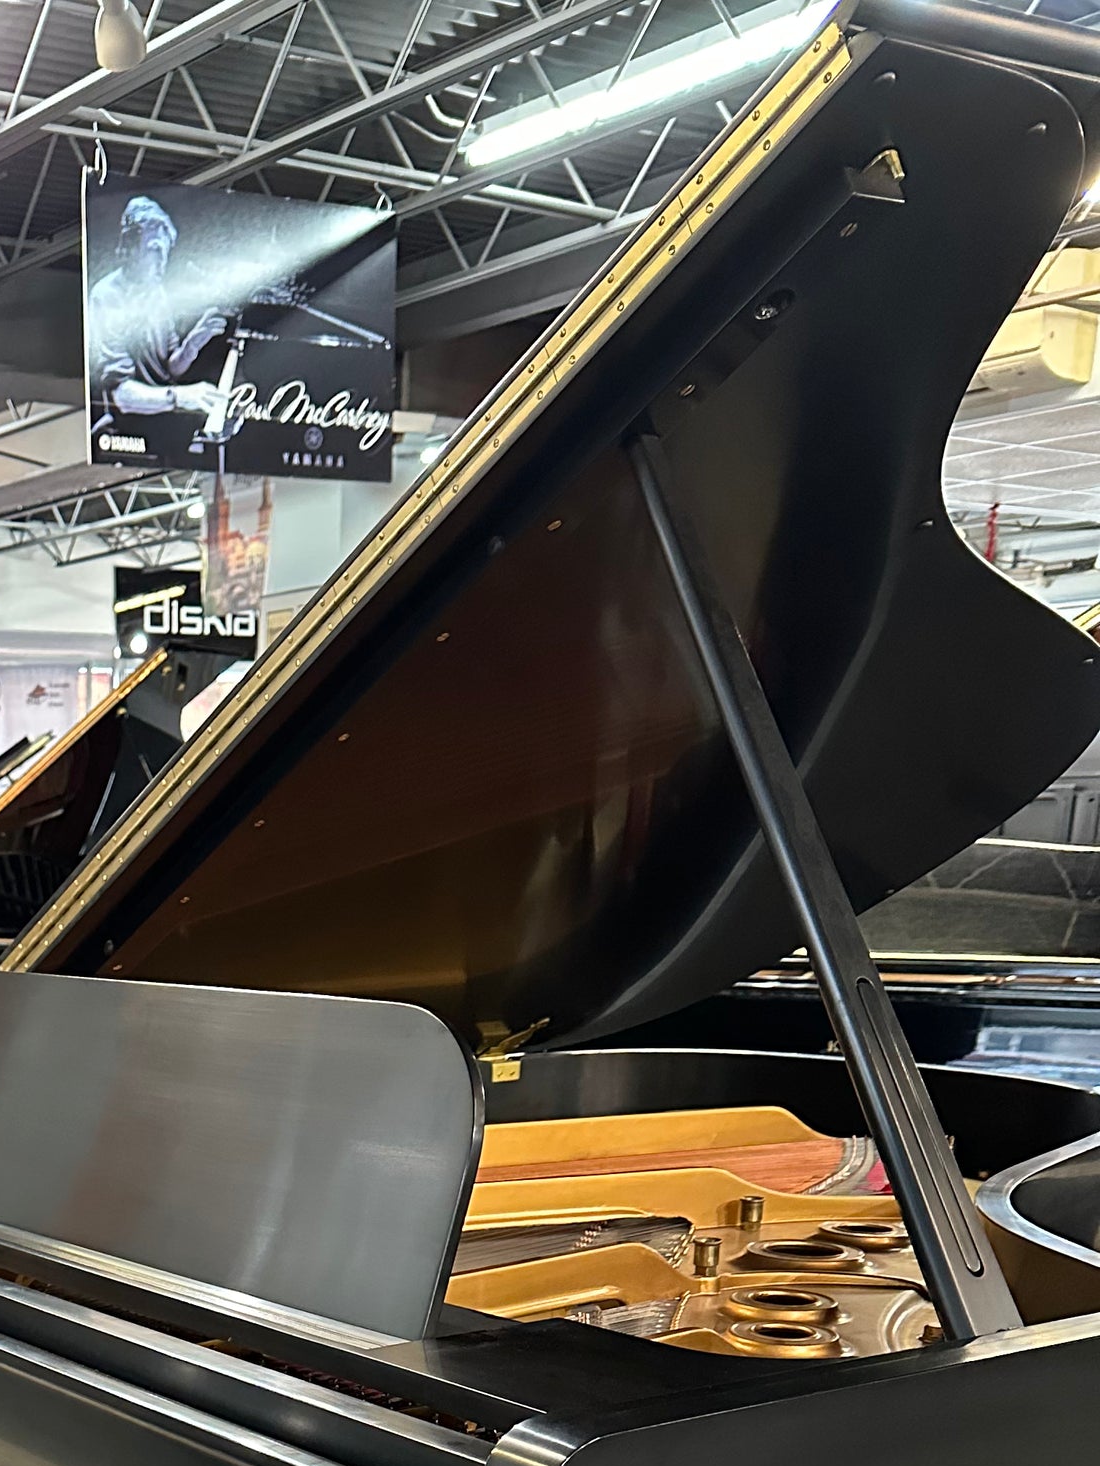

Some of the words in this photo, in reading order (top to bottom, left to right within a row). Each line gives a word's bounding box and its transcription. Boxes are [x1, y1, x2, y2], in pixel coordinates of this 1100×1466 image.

[227, 383, 279, 421] Paul
[272, 380, 390, 451] McCartney
[282, 452, 345, 468] YAMAHA
